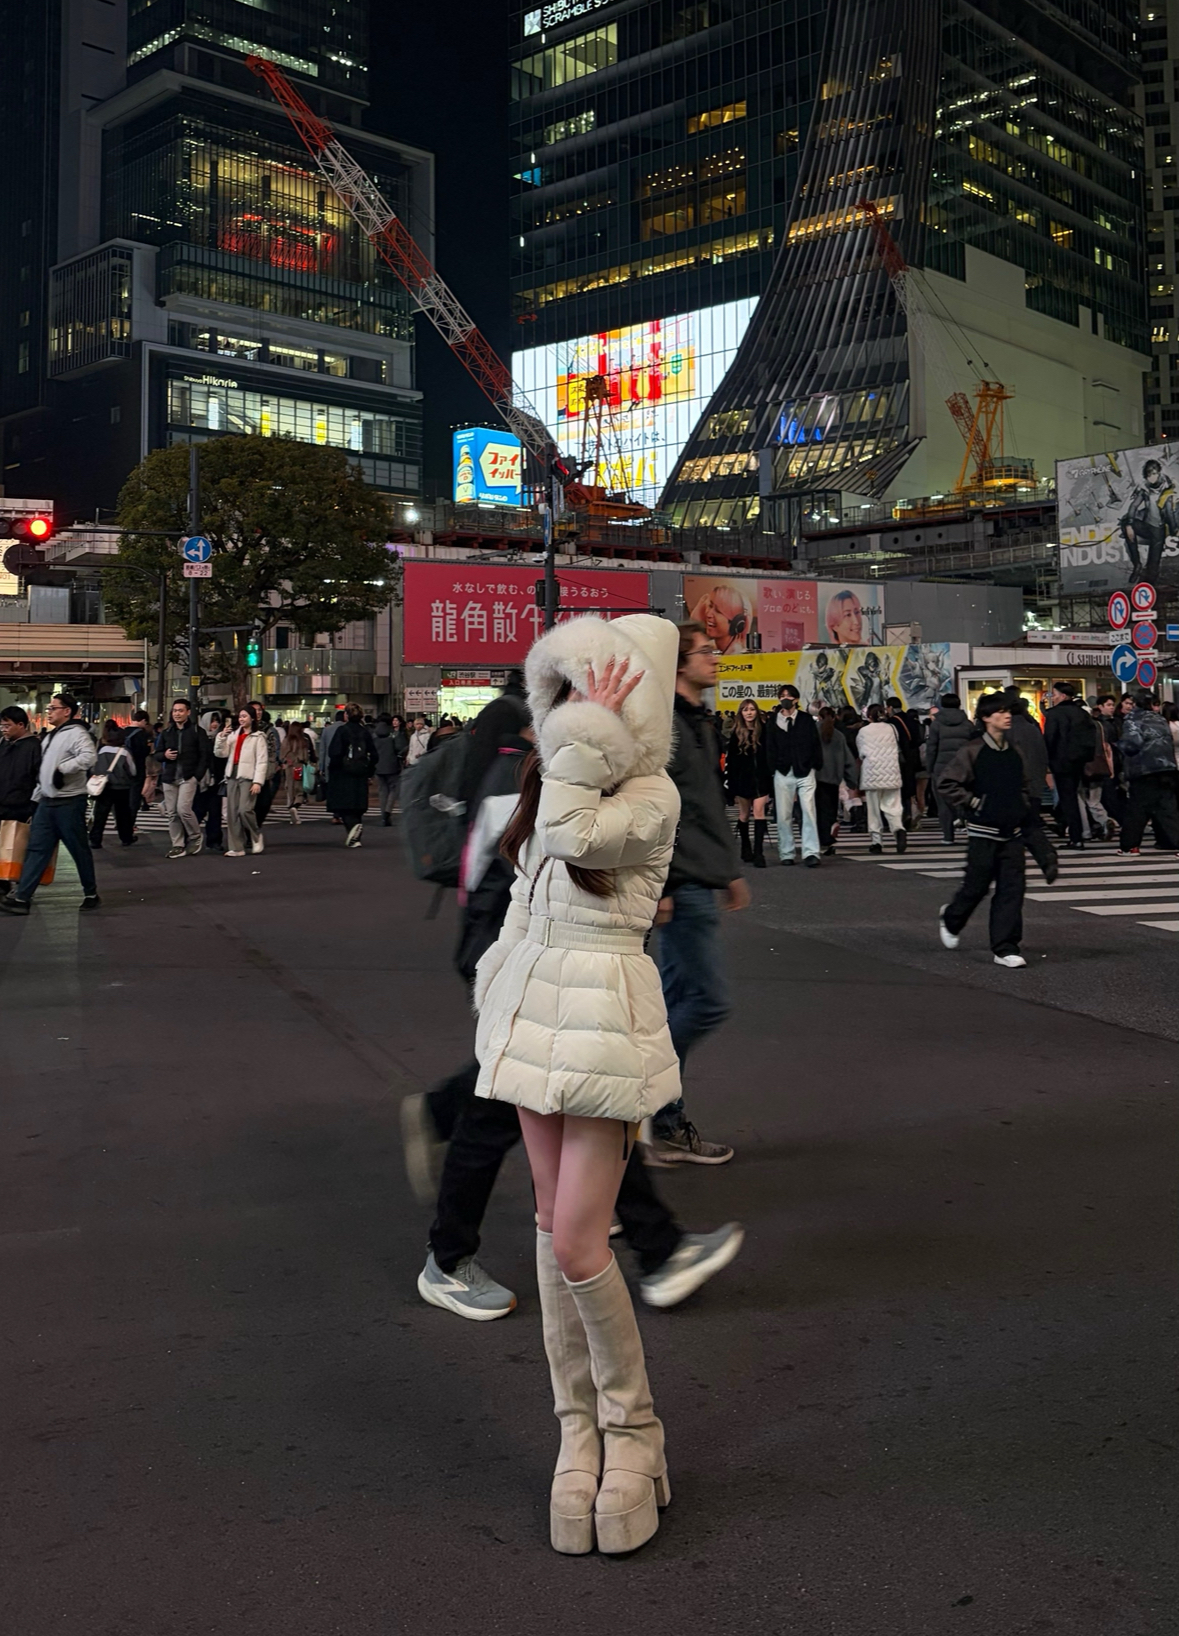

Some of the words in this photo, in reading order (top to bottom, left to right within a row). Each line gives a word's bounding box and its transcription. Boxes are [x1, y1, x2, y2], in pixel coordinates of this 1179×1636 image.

[542, 0, 583, 17] SHIBU
[542, 4, 593, 28] SCRAMBLE
[202, 375, 238, 388] Hikarie
[488, 451, 521, 466] ファイ
[1060, 535, 1179, 568] INDUSTS
[452, 582, 609, 598] 水なしで飲む、の接うるおう
